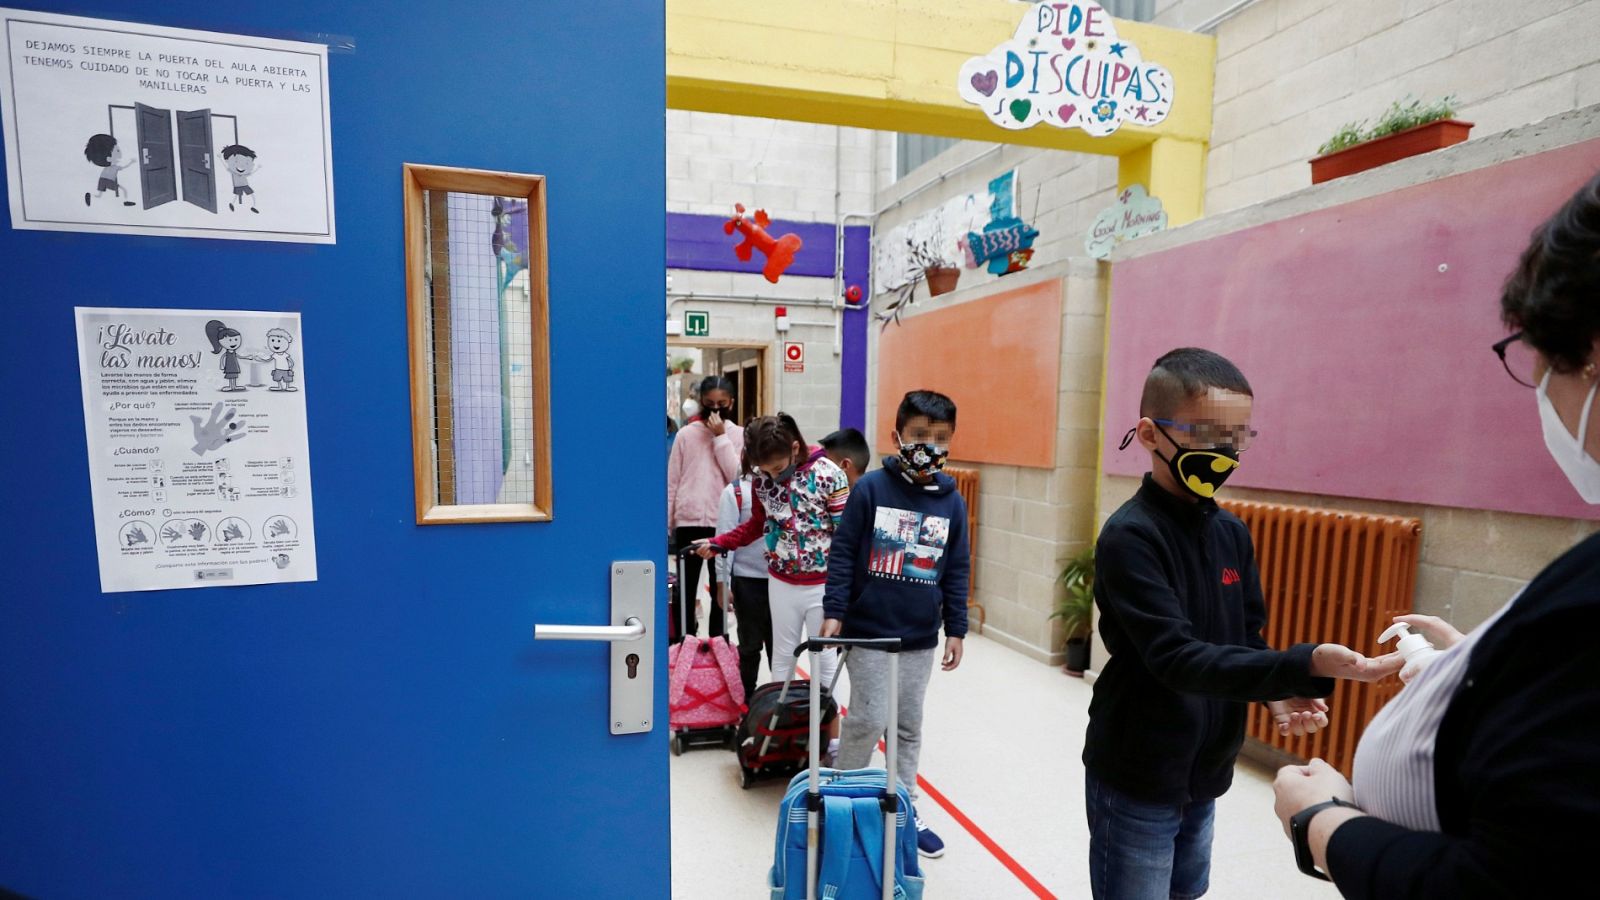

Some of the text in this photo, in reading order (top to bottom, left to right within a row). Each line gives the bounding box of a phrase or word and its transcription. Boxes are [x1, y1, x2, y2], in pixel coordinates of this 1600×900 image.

[25, 39, 308, 78] DEJAMOS SIEMPRE LA PUERTA DEL AULA ABIERTA
[23, 55, 312, 94] TENEMOS CUIDADO DE NO TOCAR LA PUERTA Y LAS
[139, 79, 208, 95] MANILLERAS
[1006, 50, 1161, 103] DISCULPAS
[98, 323, 177, 354] ¡Lávate
[101, 350, 202, 369] las manos!
[110, 401, 131, 411] ¿Por
